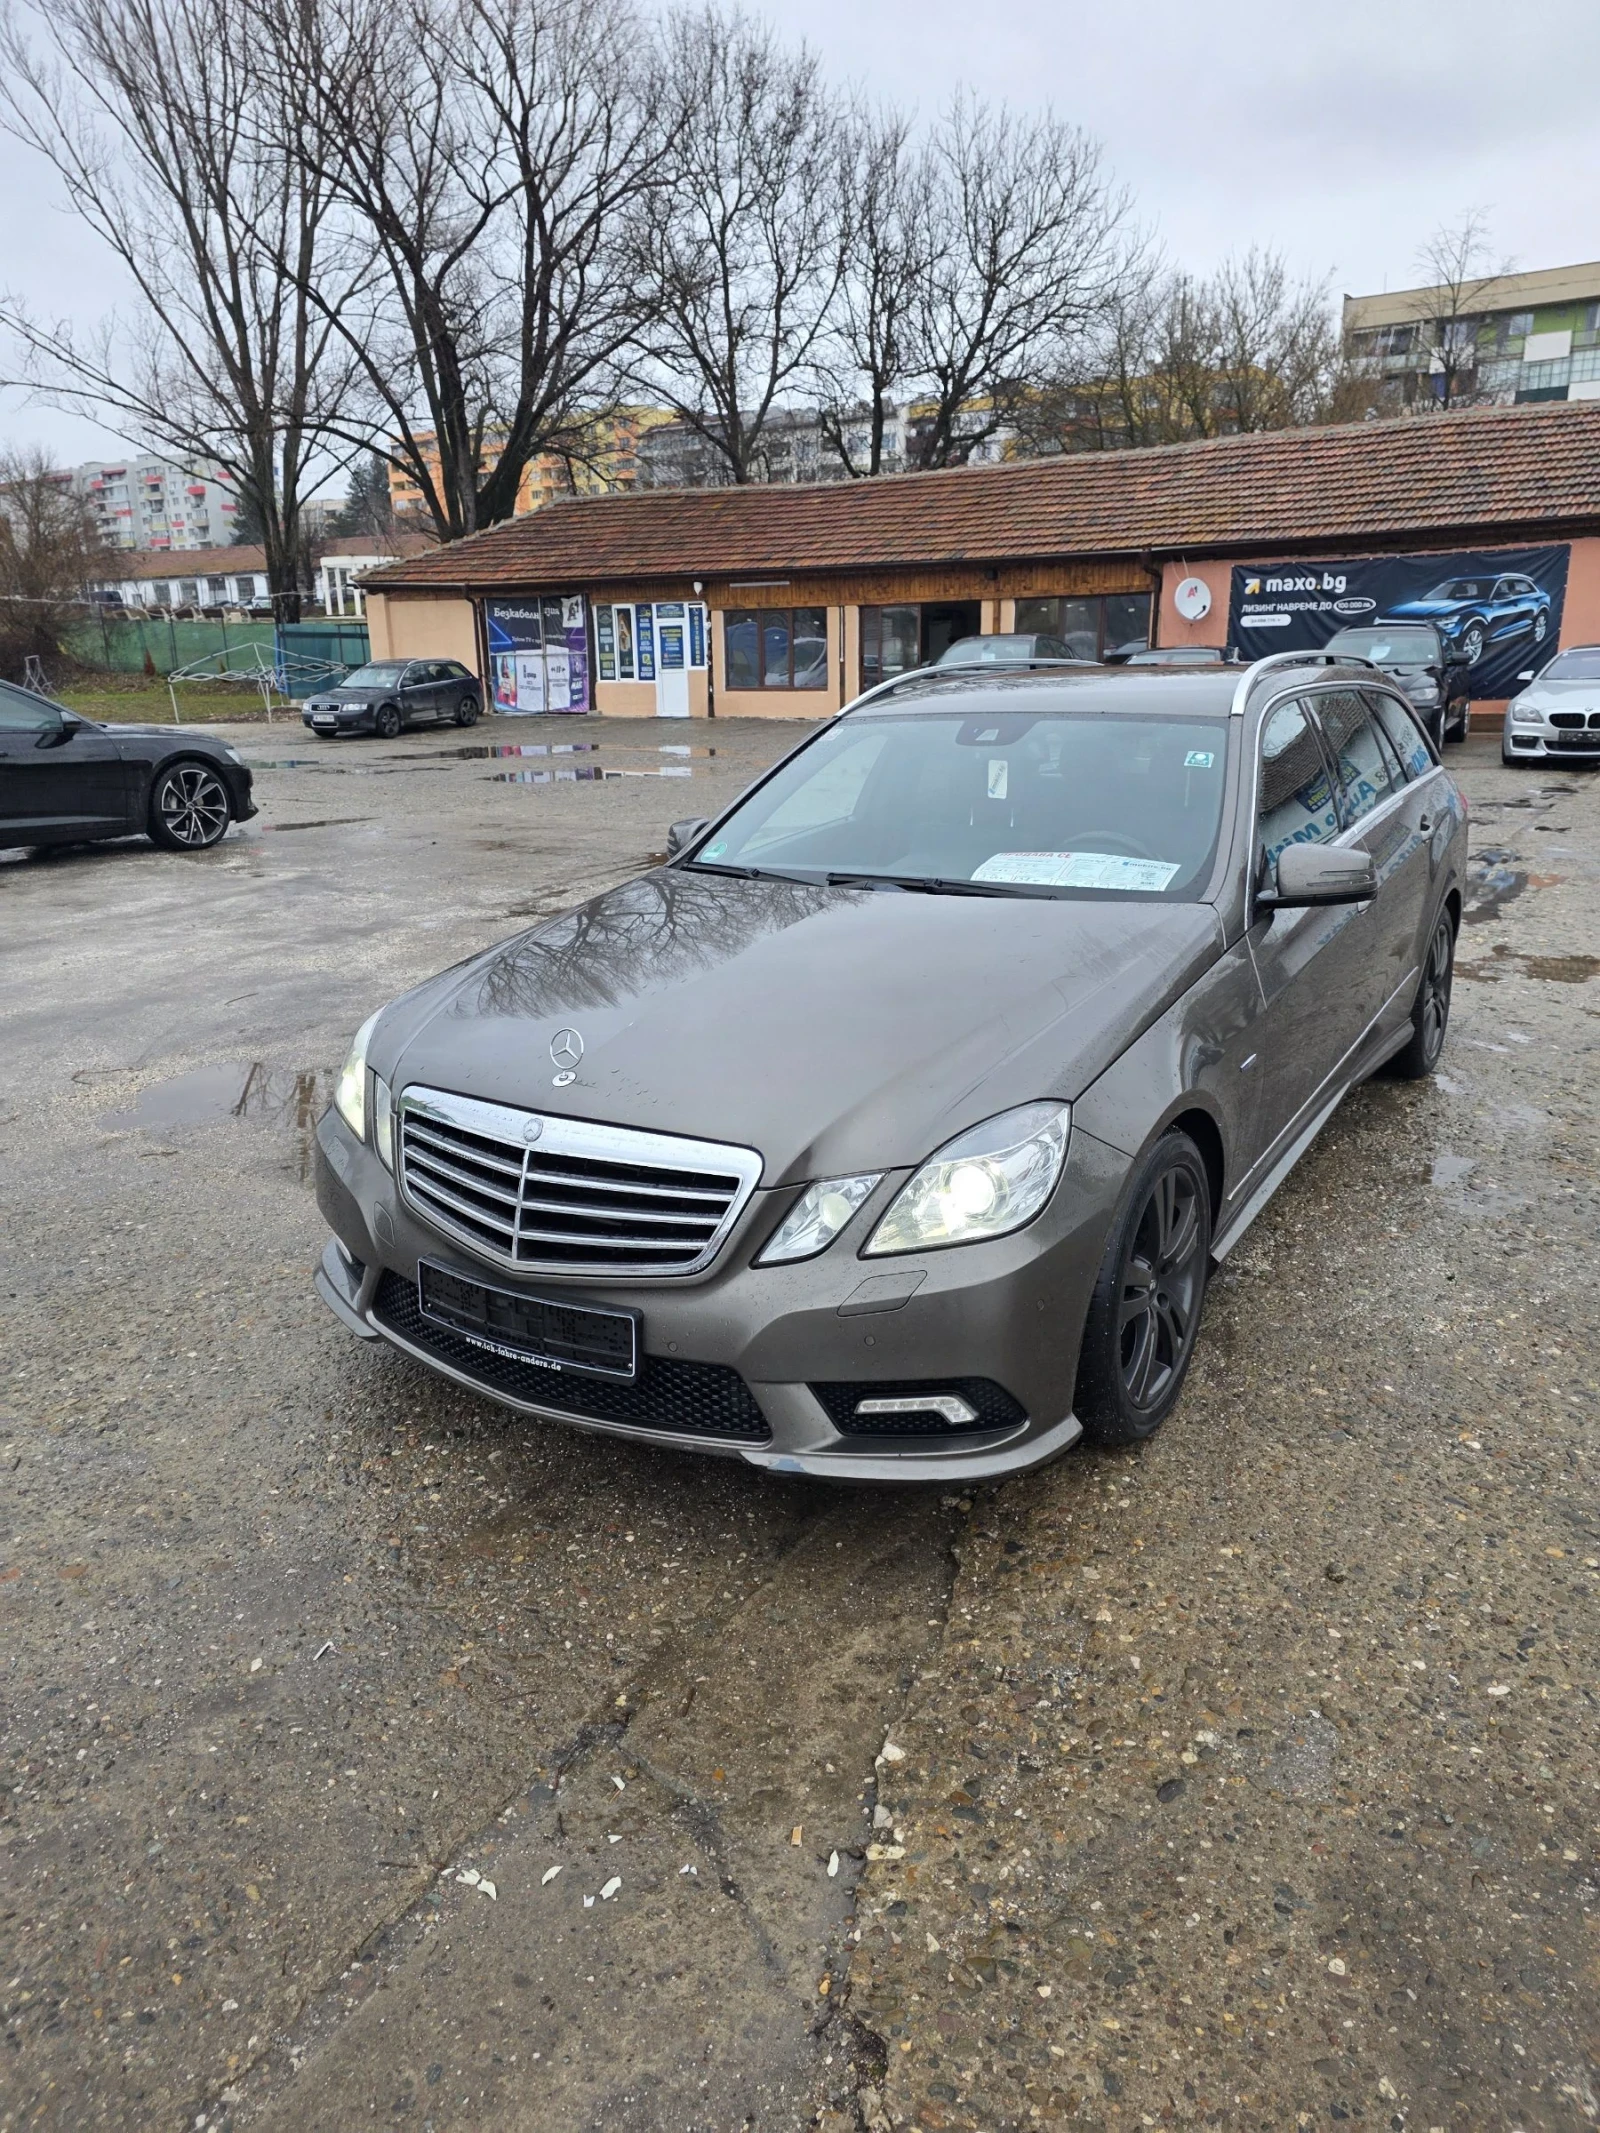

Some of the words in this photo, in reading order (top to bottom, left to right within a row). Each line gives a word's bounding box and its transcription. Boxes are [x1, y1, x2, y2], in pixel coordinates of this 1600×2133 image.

[1266, 572, 1347, 594] maxo.bg
[1187, 585, 1198, 598] A1
[493, 607, 541, 620] Безкабелн
[1241, 603, 1275, 613] ЛИЗИНГ
[1276, 602, 1318, 612] НАВРЕМЕ
[1319, 601, 1333, 611] ДО
[465, 1336, 562, 1371] www.ich-fahre-anders.de
